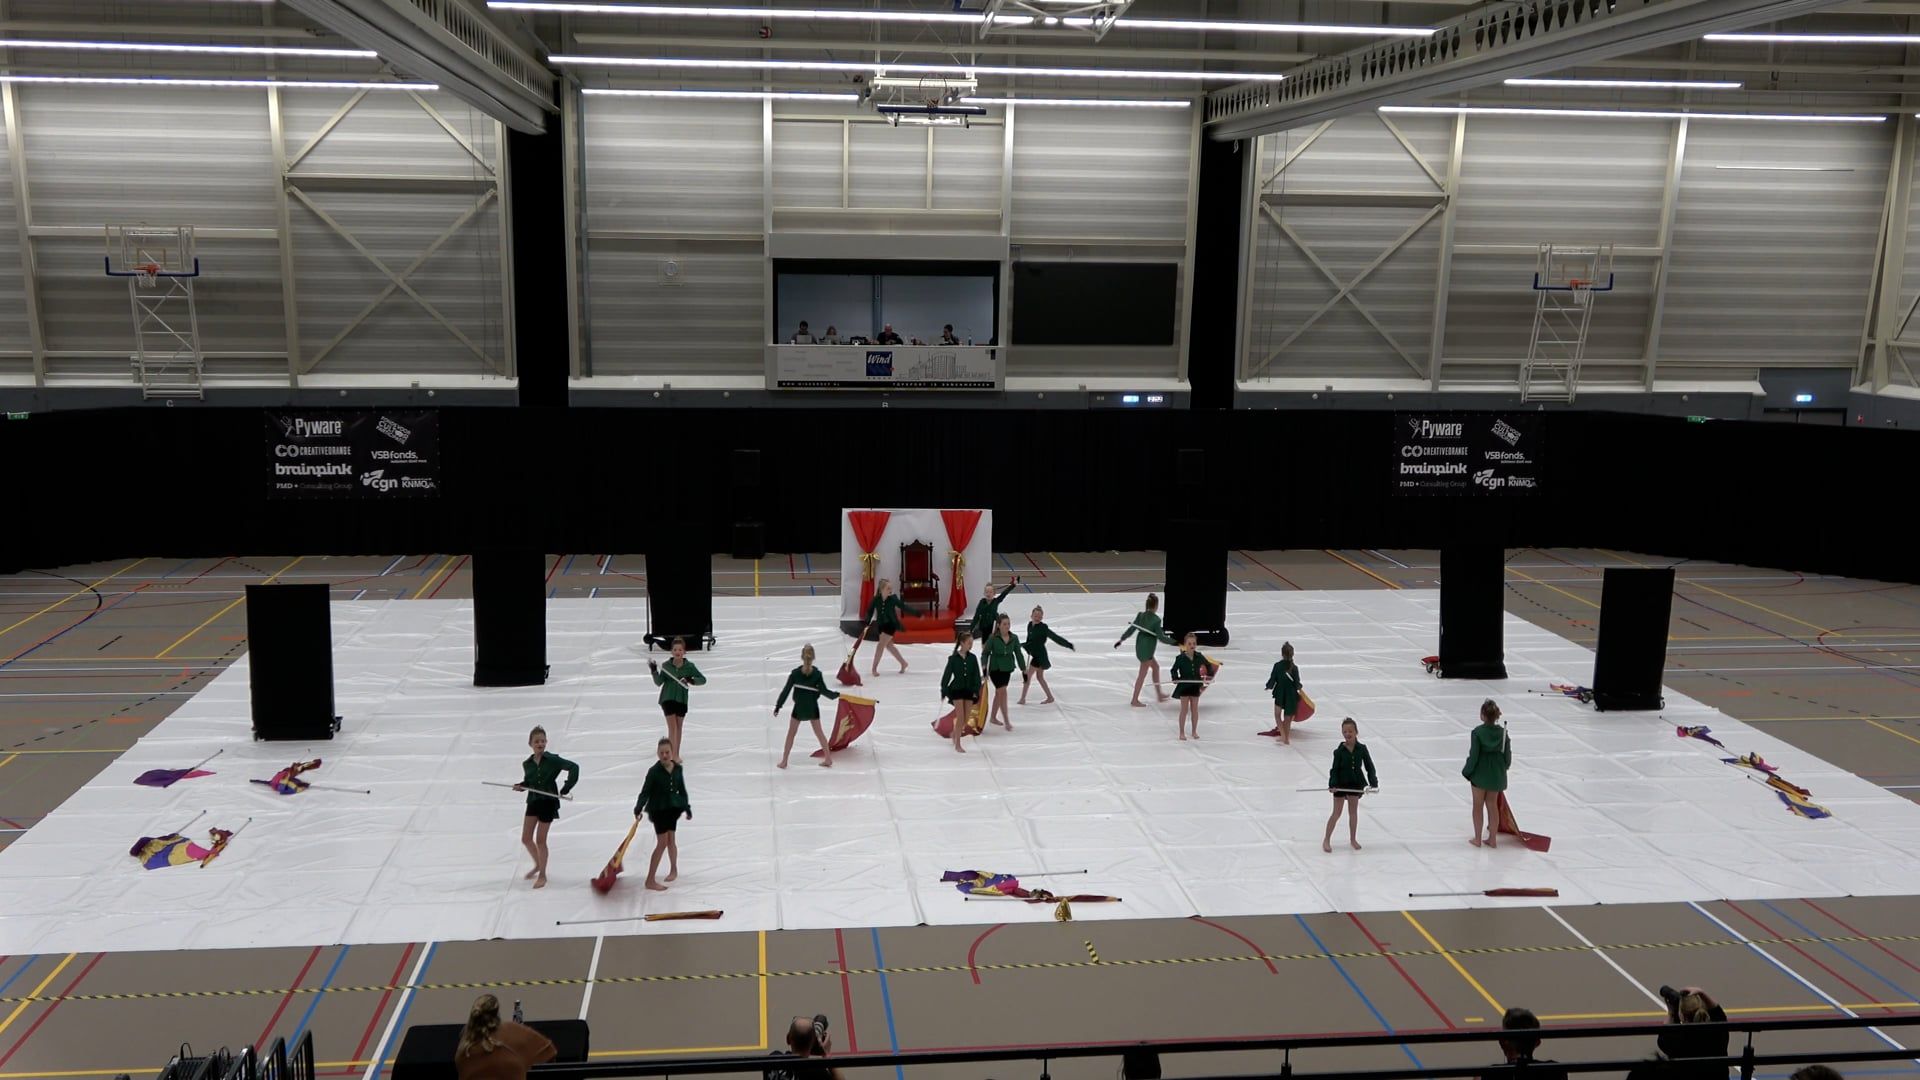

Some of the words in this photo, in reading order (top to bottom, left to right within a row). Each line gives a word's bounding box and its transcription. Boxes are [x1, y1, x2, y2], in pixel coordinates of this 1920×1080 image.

[868, 354, 892, 364] Wind
[294, 418, 342, 437] Pyware
[1422, 420, 1462, 438] Pyware
[275, 462, 353, 477] brainpink
[1400, 462, 1468, 476] brainpink
[372, 478, 398, 492] cgn
[1482, 477, 1505, 490] cgn
